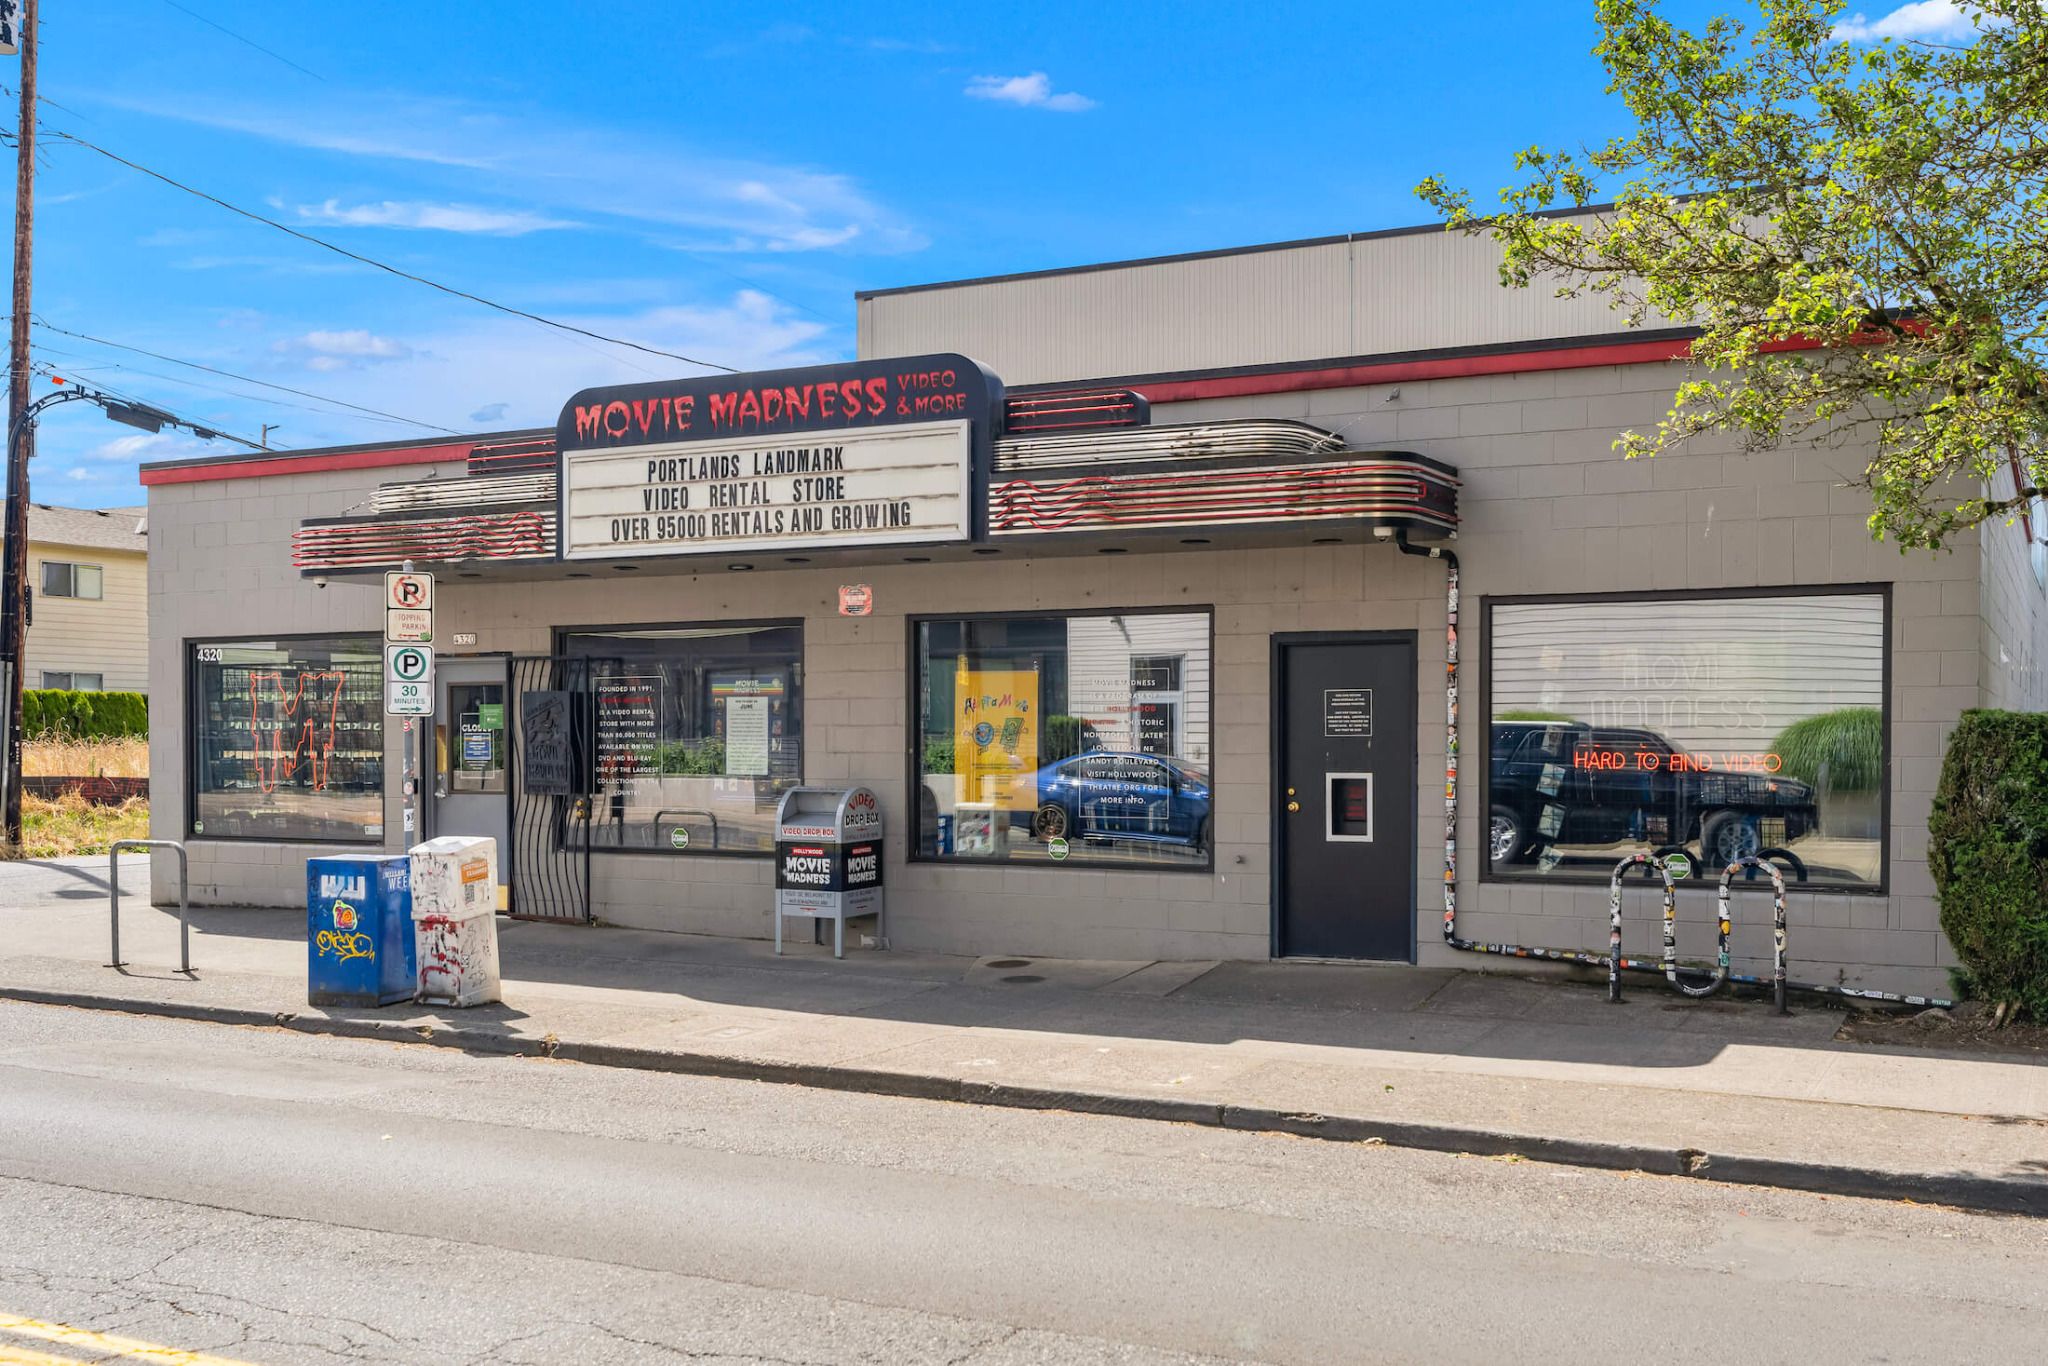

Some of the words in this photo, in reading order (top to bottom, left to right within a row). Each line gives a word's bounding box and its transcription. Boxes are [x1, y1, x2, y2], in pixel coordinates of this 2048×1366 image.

[897, 369, 957, 392] VIDEO
[575, 395, 695, 442] MOVIE
[709, 377, 888, 430] MADNESS
[896, 399, 912, 416] &
[915, 392, 967, 415] MORE
[647, 454, 740, 483] PORTLANDS
[753, 446, 844, 476] LANDMARK
[643, 486, 689, 511] VIDEO
[709, 480, 771, 508] RENTAL
[793, 476, 845, 503] STORE
[611, 517, 650, 542] OVER
[657, 513, 706, 539] 95000
[711, 509, 784, 537] RENTALS
[791, 506, 823, 533] AND
[831, 501, 911, 531] GROWING
[402, 582, 419, 602] P
[197, 648, 223, 662] 4320
[403, 655, 419, 673] P
[401, 685, 418, 697] 30
[735, 679, 760, 688] MOVIE
[394, 697, 426, 705] MINUTES
[1574, 751, 1626, 770] HARD
[1633, 752, 1661, 771] TO
[1669, 753, 1713, 773] FIND
[1721, 753, 1782, 773] VIDEO
[848, 793, 876, 811] VIDEO
[1100, 796, 1123, 804] MORE
[1125, 796, 1147, 804] INFO.
[845, 814, 864, 827] DROP
[866, 811, 879, 825] BOX
[782, 827, 801, 835] VIDEO
[803, 827, 821, 836] DROP
[822, 828, 835, 836] BOX
[785, 856, 831, 873] MOVIE
[847, 855, 876, 873] MOVIE
[388, 875, 411, 891] WEE
[786, 872, 831, 885] MADNESS
[848, 870, 876, 884] MADNESS
